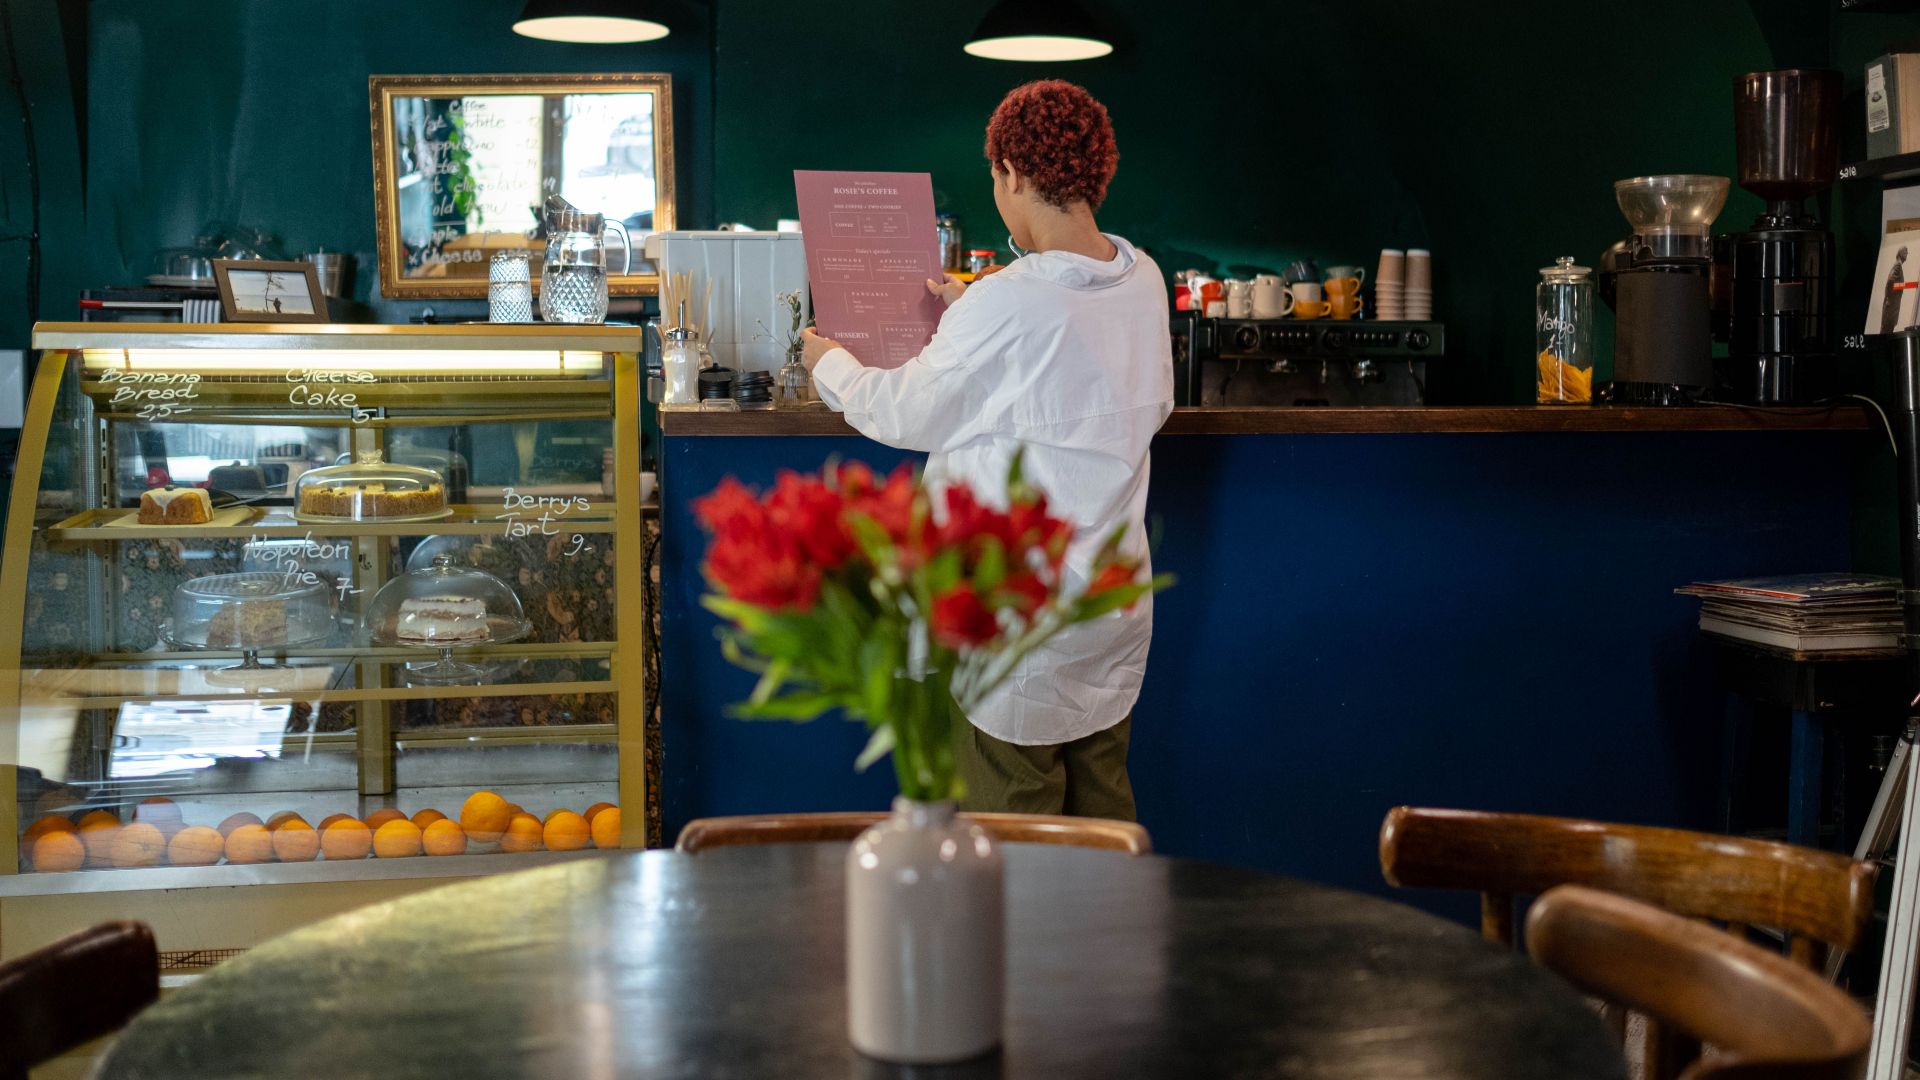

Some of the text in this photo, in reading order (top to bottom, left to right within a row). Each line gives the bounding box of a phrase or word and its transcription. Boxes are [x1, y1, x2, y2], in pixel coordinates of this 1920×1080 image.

[833, 187, 898, 196] ROSIE'S COFFEE
[834, 331, 870, 339] DESSERTS
[98, 367, 201, 384] Banana
[285, 367, 378, 383] Cheese
[109, 383, 199, 403] Bread
[289, 385, 358, 408] Cake
[502, 486, 591, 515] Berry's
[495, 511, 560, 538] Tart
[243, 530, 349, 569] Napoleon
[283, 559, 320, 586] Pie
